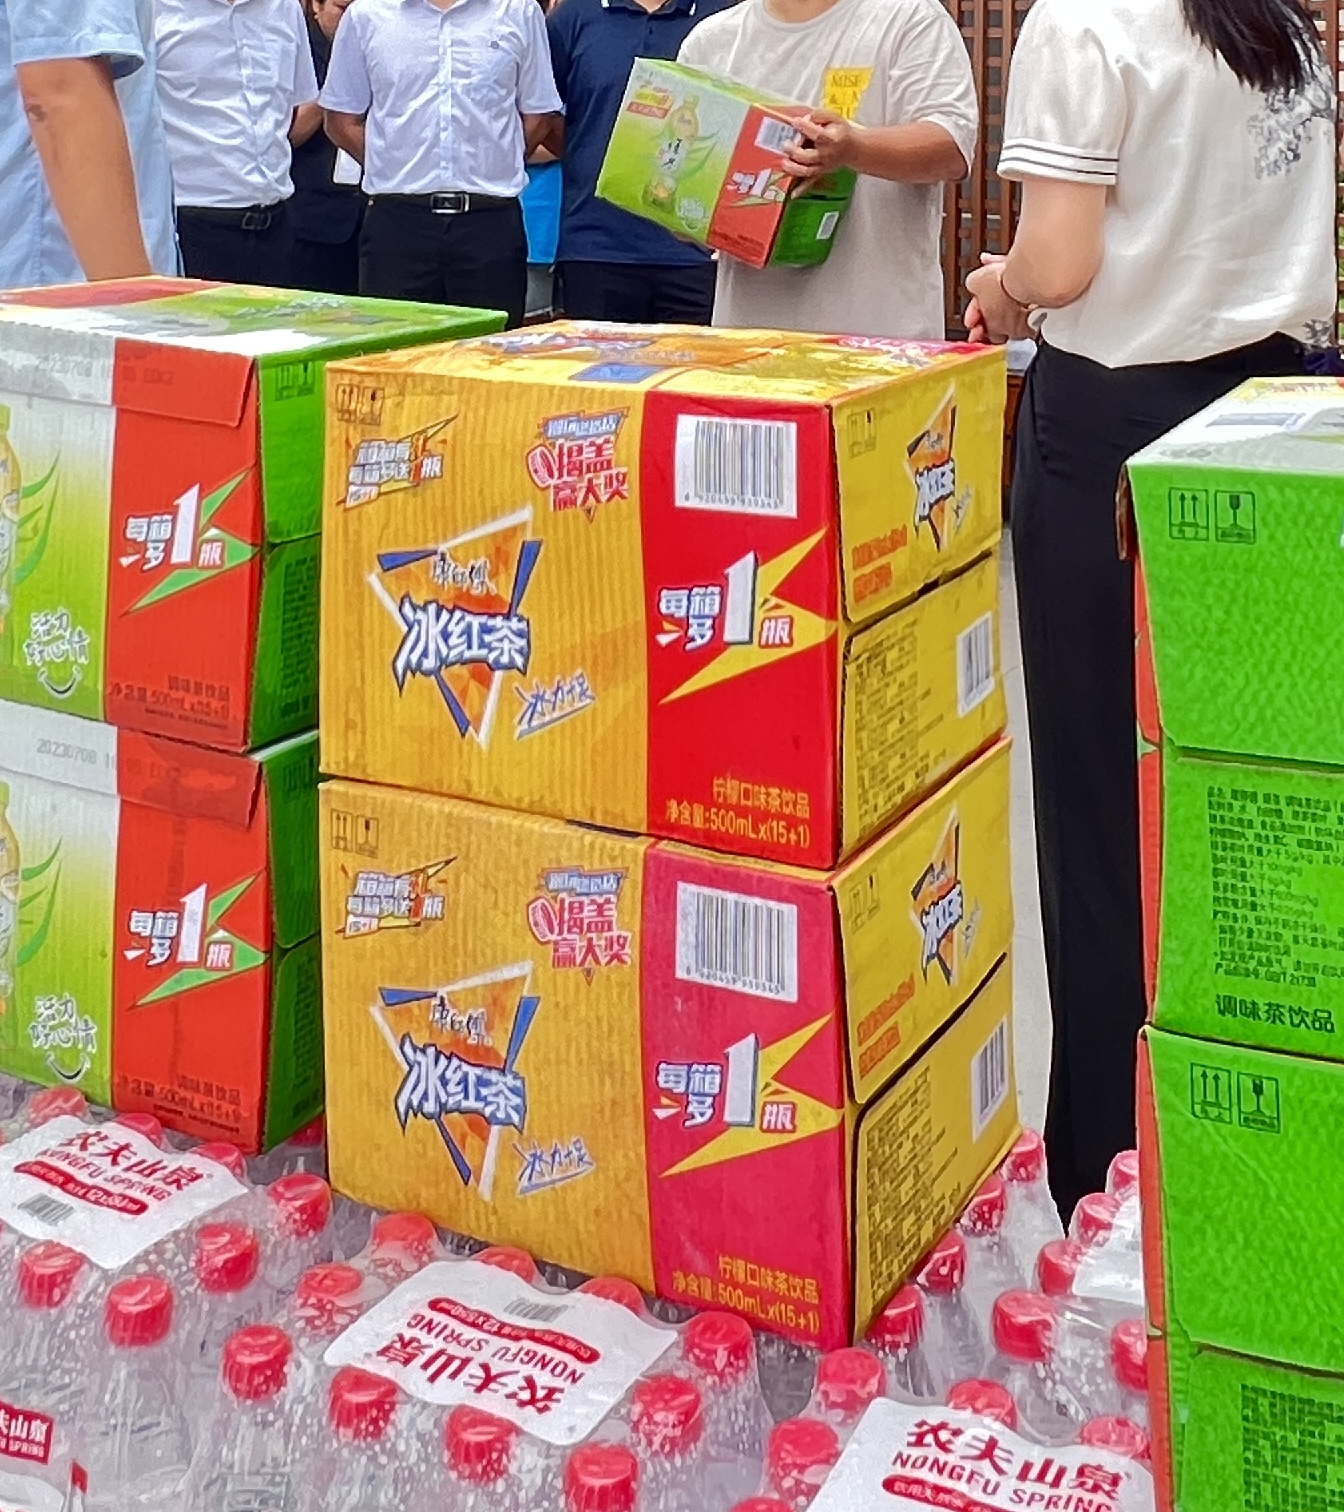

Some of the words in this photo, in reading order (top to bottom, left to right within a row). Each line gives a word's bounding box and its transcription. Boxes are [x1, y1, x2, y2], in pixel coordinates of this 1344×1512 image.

[396, 594, 530, 692] 冰红茶
[713, 775, 810, 819] 柠檬口味茶饮品
[556, 893, 616, 937] 揭盖
[1215, 993, 1336, 1034] 调味茶饮品
[396, 1032, 528, 1131] 冰红茶
[57, 1130, 205, 1191] 农夫山泉
[718, 1254, 819, 1306] 柠檬口味茶饮品
[406, 1312, 490, 1353] SPRING
[376, 1332, 565, 1414] 农夫山泉
[490, 1345, 586, 1386] NONGFU
[891, 1451, 1002, 1497] NONGFU
[906, 1418, 1124, 1501] 农夫山泉
